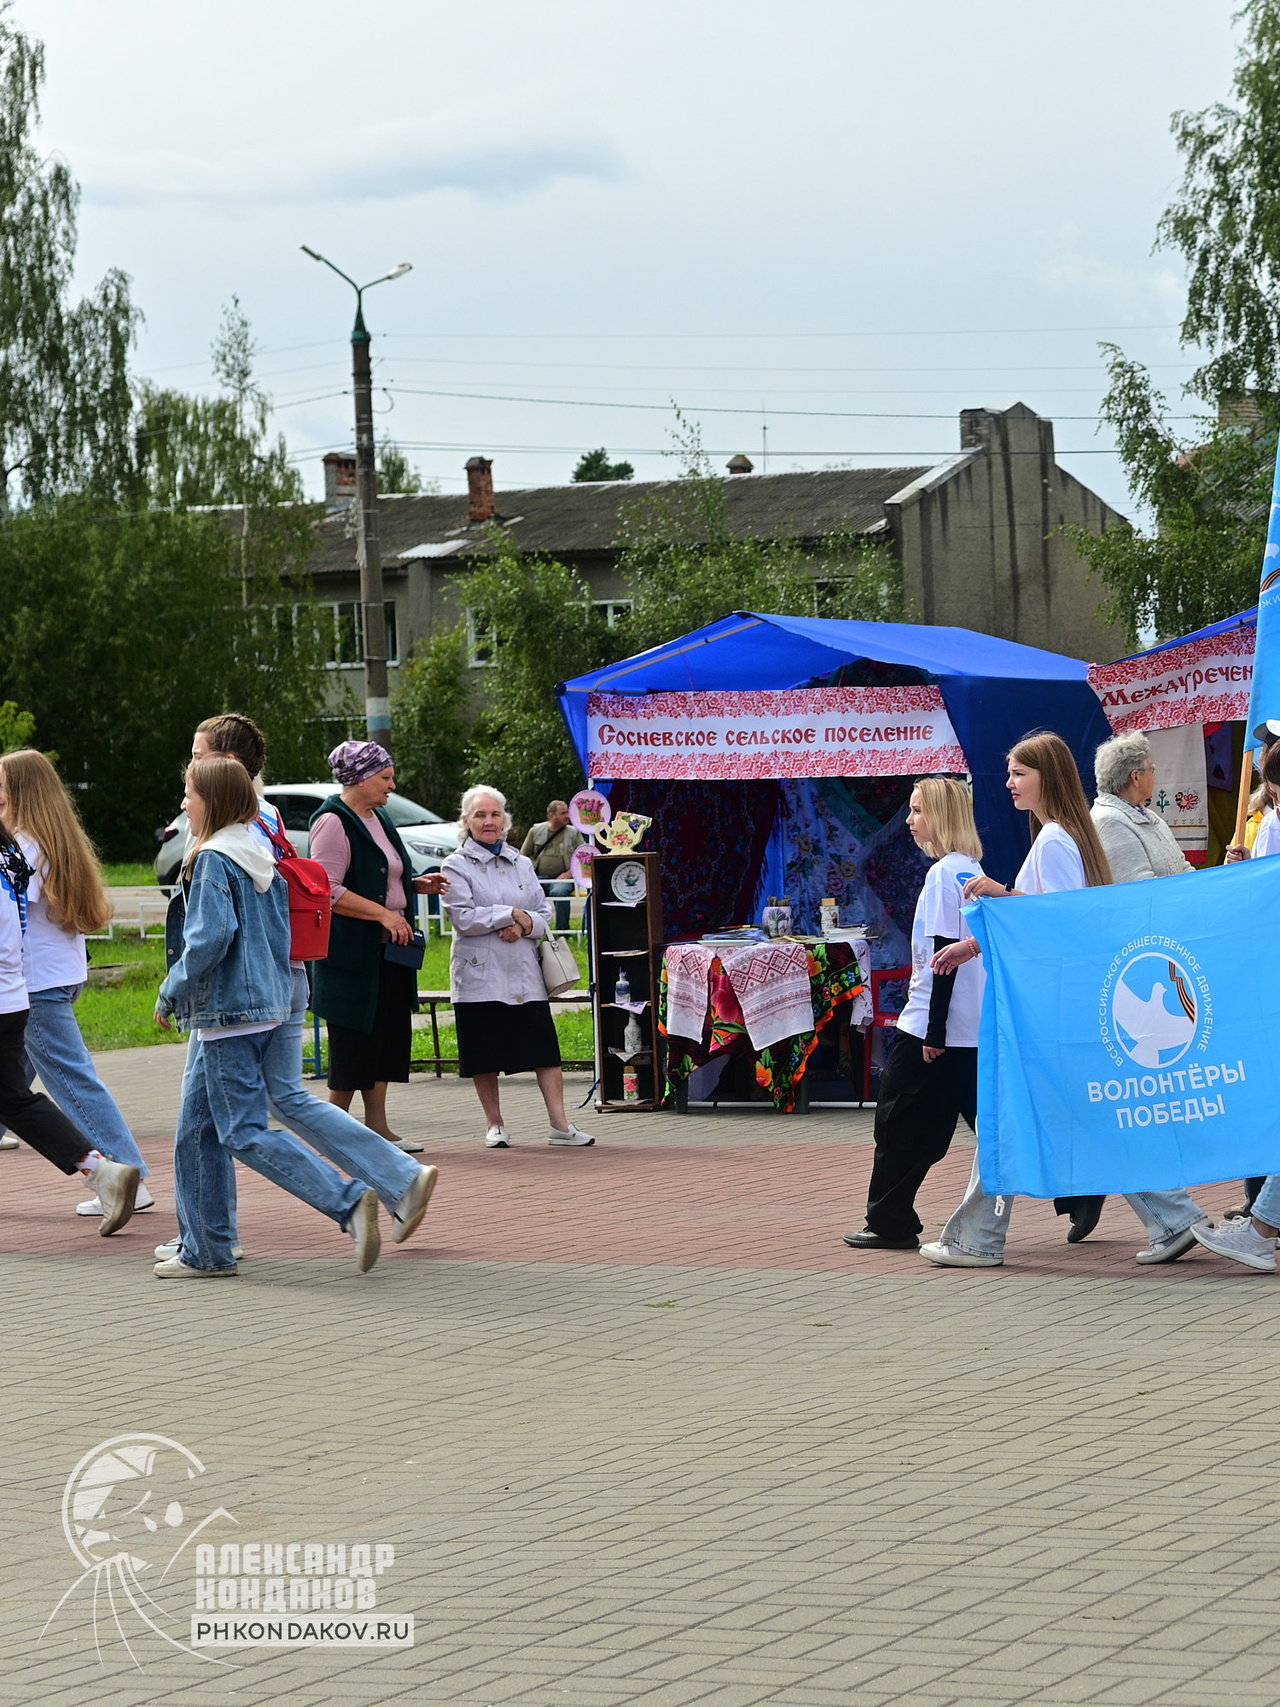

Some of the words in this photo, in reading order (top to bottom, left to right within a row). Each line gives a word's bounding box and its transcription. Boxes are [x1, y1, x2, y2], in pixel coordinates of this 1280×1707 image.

[1102, 665, 1254, 707] Междуречен
[598, 723, 717, 747] Сосневское
[725, 727, 815, 745] сельское
[825, 724, 934, 743] поселение
[1098, 955, 1123, 1067] ВСЕРОССИЙСКОЕ
[1121, 935, 1201, 973] ОБЩЕСТВЕННОЕ
[1195, 975, 1214, 1053] ДВИЖЕНИЕ
[1087, 1060, 1246, 1103] ВОЛОНТЁРЫ
[1115, 1094, 1226, 1129] ПОБЕДЫ
